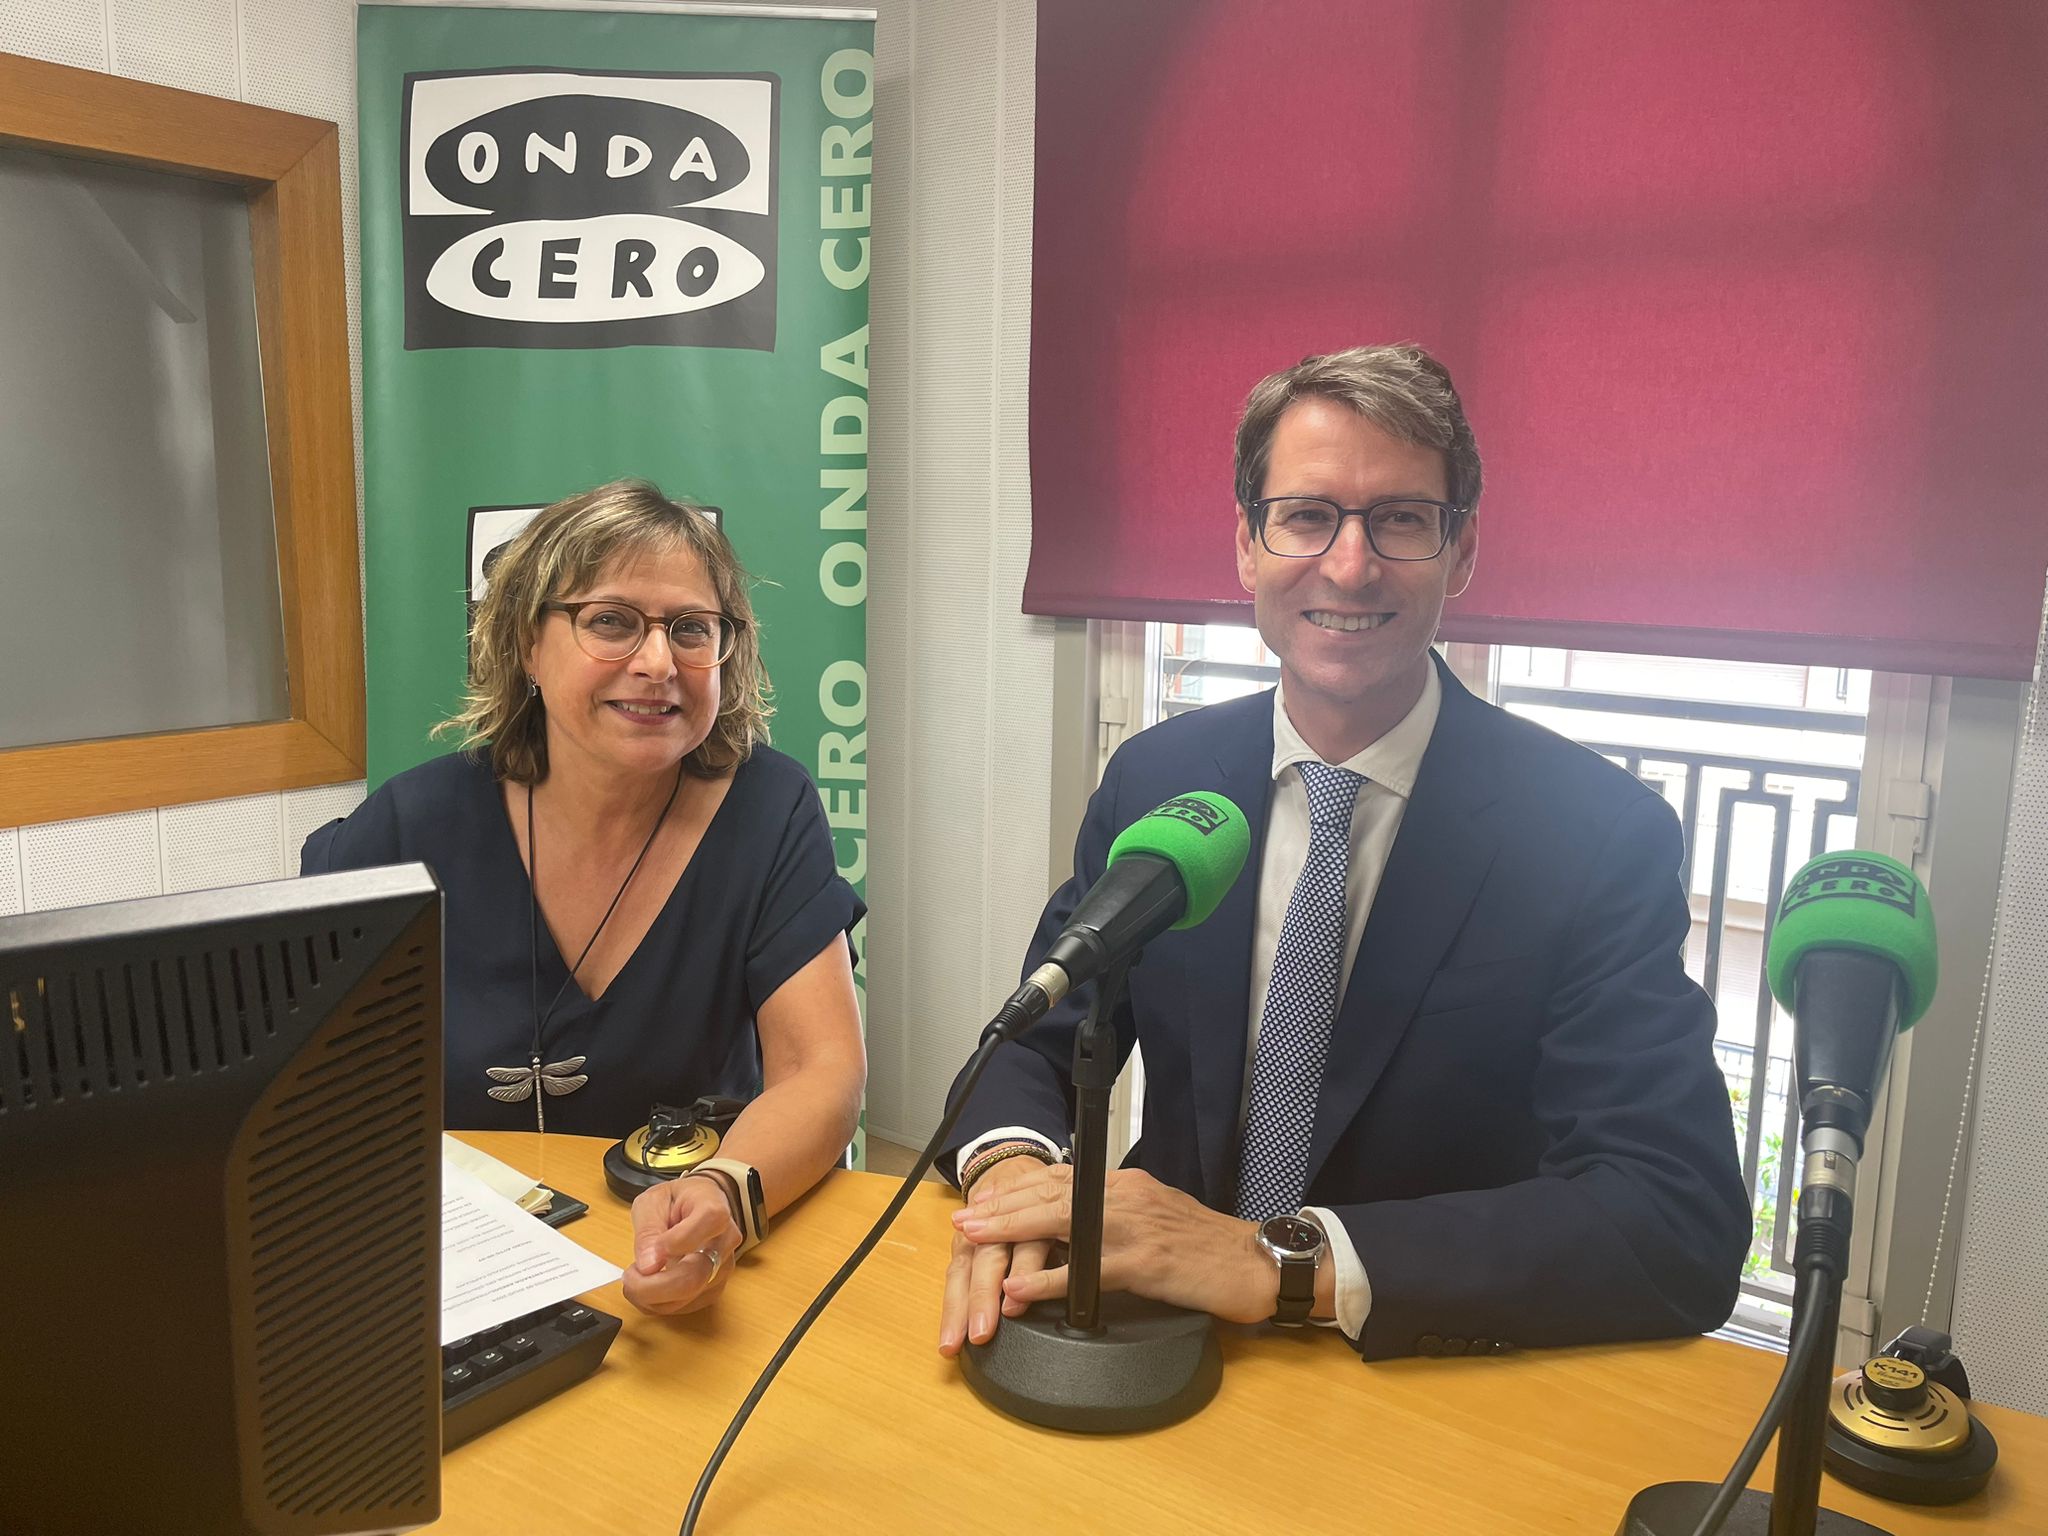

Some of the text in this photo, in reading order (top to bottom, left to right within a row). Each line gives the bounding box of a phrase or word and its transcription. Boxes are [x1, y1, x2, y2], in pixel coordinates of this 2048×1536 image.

[457, 130, 717, 184] ONDA
[820, 48, 875, 291] CERO
[471, 237, 719, 299] CERO
[819, 323, 869, 607] ONDA
[1873, 1362, 1918, 1379] K141
